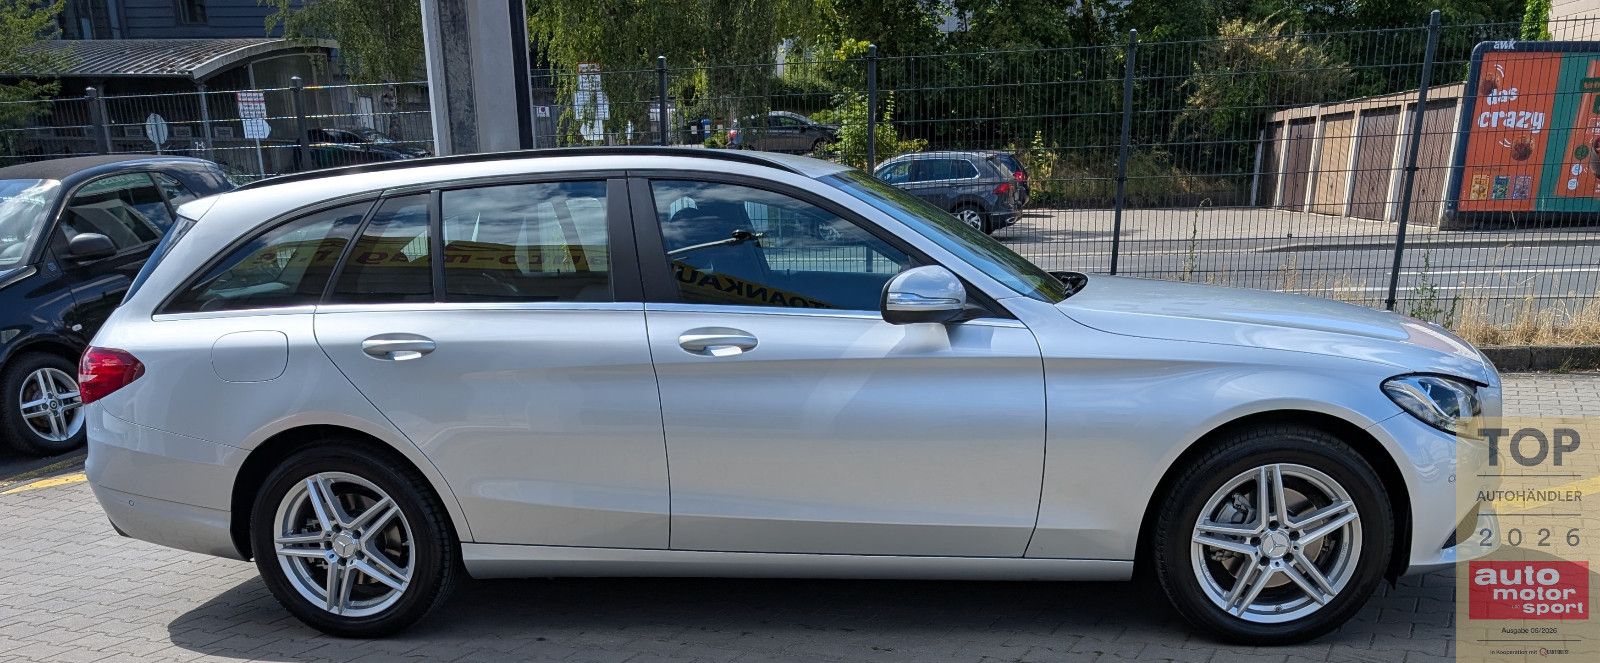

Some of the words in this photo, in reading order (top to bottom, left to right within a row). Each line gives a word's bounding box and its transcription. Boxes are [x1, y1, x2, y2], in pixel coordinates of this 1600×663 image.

[1493, 38, 1517, 50] awk
[1486, 87, 1518, 106] das
[1477, 111, 1545, 133] crazy
